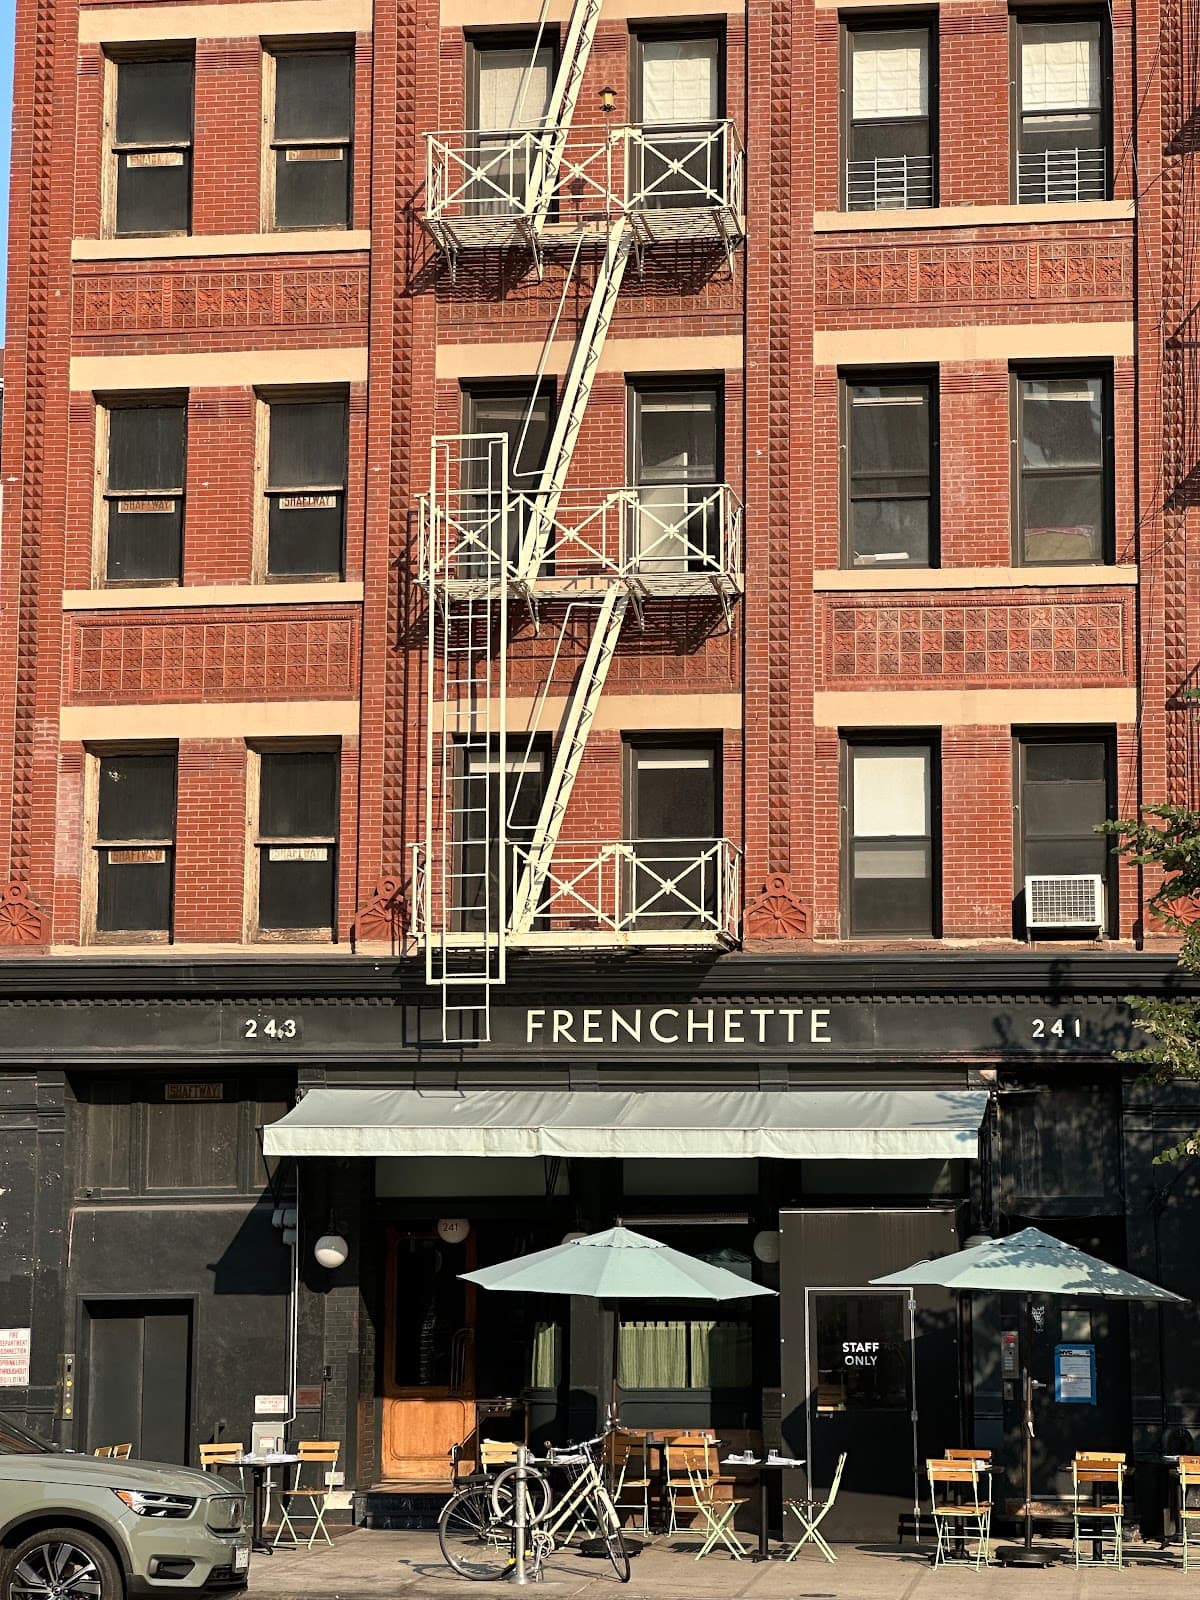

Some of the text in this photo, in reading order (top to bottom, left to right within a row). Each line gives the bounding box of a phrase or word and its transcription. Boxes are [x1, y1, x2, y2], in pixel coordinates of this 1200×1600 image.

[245, 1019, 296, 1038] 243
[526, 1008, 832, 1043] FRENCHETTE
[1032, 1018, 1080, 1038] 241
[168, 1084, 218, 1097] SHAFTWAY
[442, 1222, 458, 1232] 241
[842, 1341, 880, 1353] STAFF
[844, 1355, 878, 1366] ONLY
